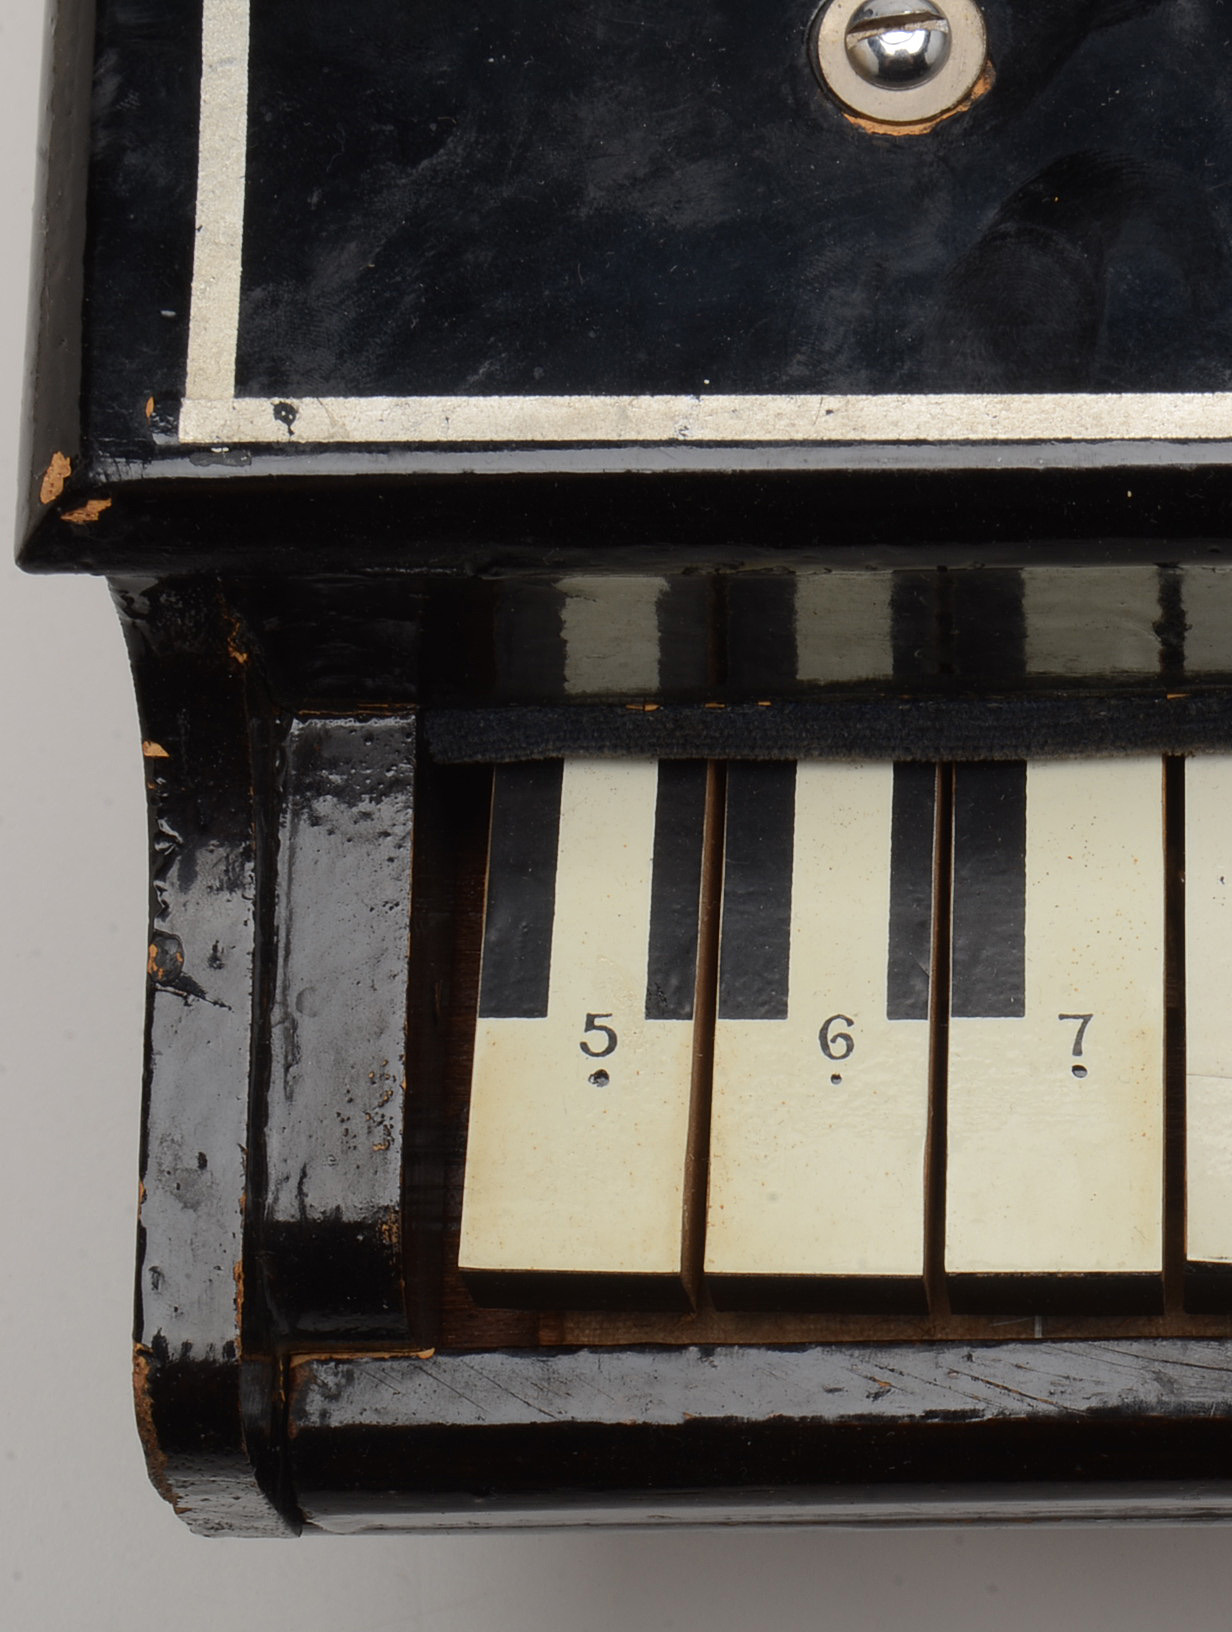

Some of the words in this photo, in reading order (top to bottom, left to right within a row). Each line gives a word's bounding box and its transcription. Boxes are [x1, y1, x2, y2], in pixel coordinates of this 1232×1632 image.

[579, 1012, 618, 1058] 5
[818, 1014, 855, 1060] 6
[1058, 1013, 1093, 1057] 7
